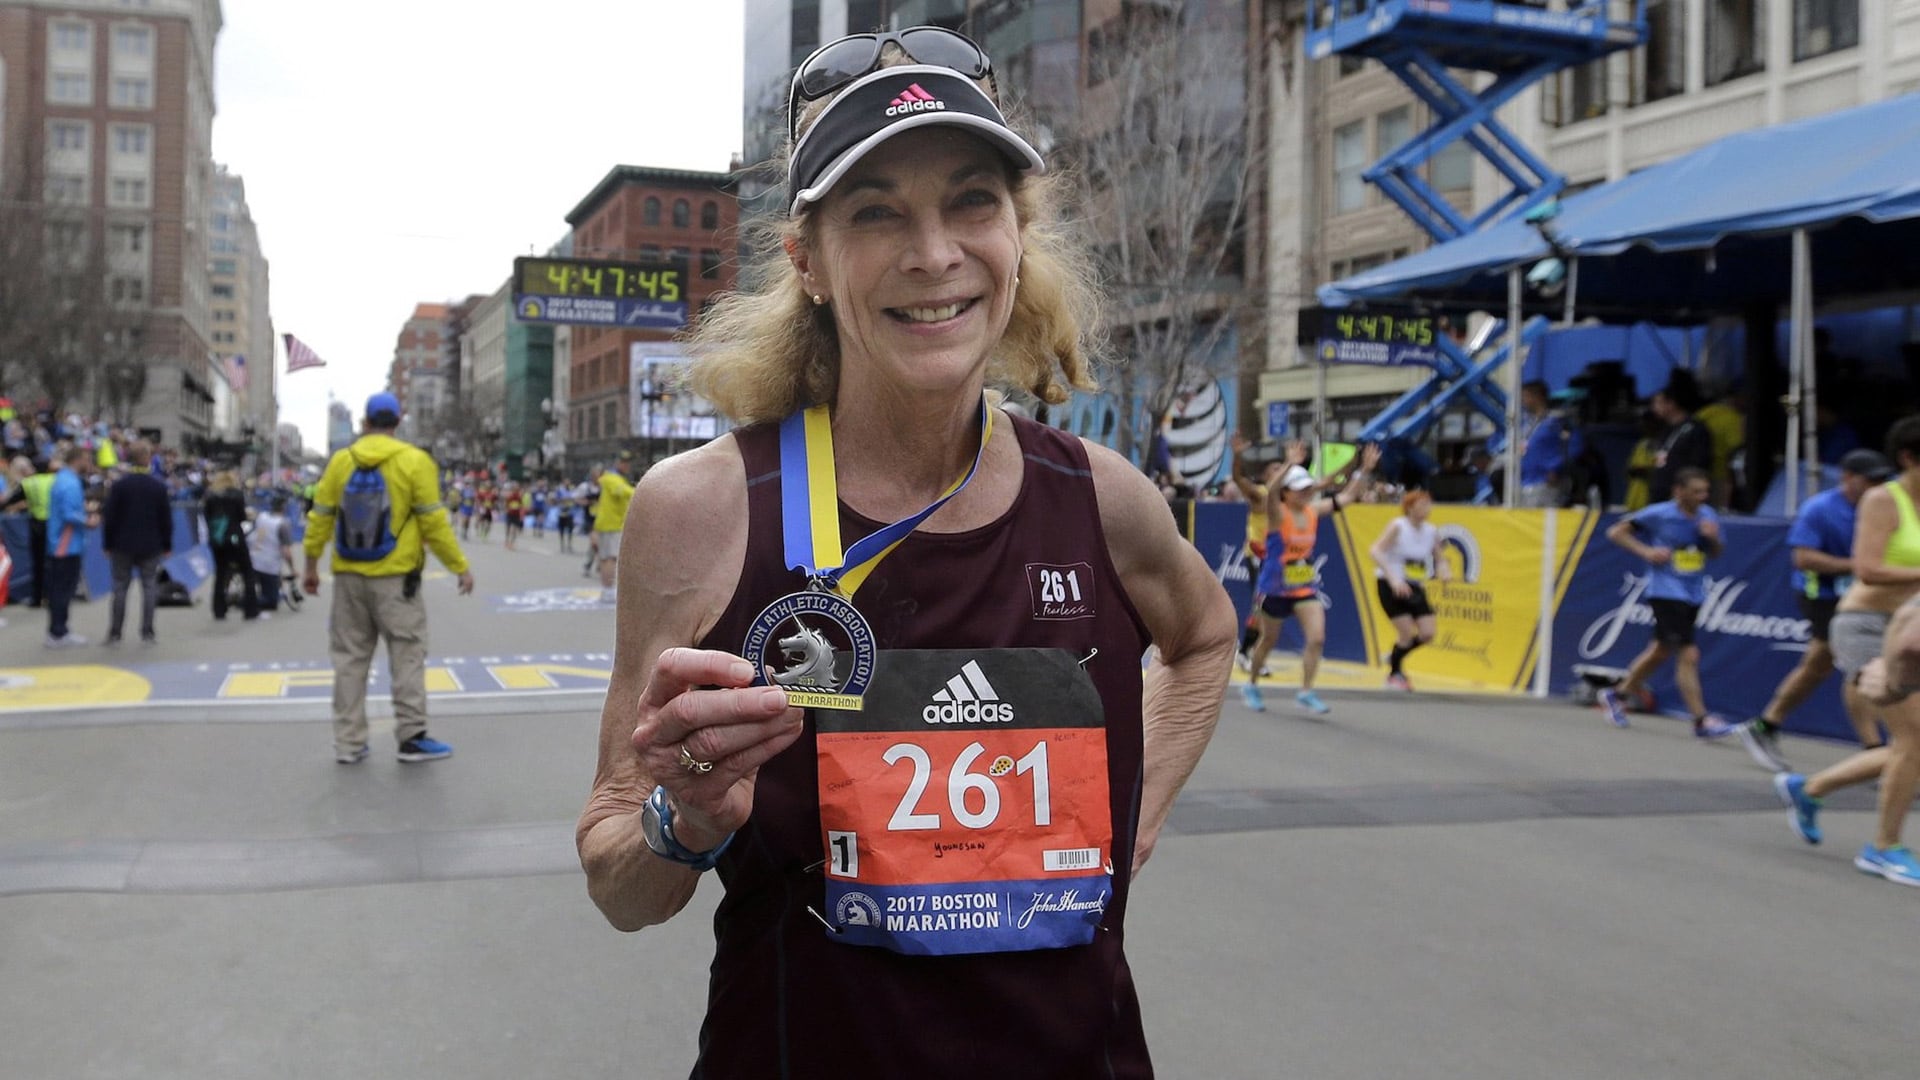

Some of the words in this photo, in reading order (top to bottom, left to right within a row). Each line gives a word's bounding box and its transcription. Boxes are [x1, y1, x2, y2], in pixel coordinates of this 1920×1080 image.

[886, 99, 945, 116] adidas
[548, 265, 679, 302] 4:47:45
[1337, 314, 1432, 345] 4:47:45
[1041, 569, 1081, 602] 261
[1042, 603, 1088, 616] Fearless
[764, 596, 828, 627] ATHLETIC
[828, 602, 871, 687] ASSOCIATION
[807, 694, 859, 708] MARATHON
[922, 700, 1015, 723] adidas
[881, 741, 1051, 831] 261
[832, 835, 849, 873] 1
[886, 896, 926, 912] 2017
[932, 893, 997, 911] BOSTON
[1017, 891, 1057, 930] John
[886, 911, 1001, 932] MARATHON
